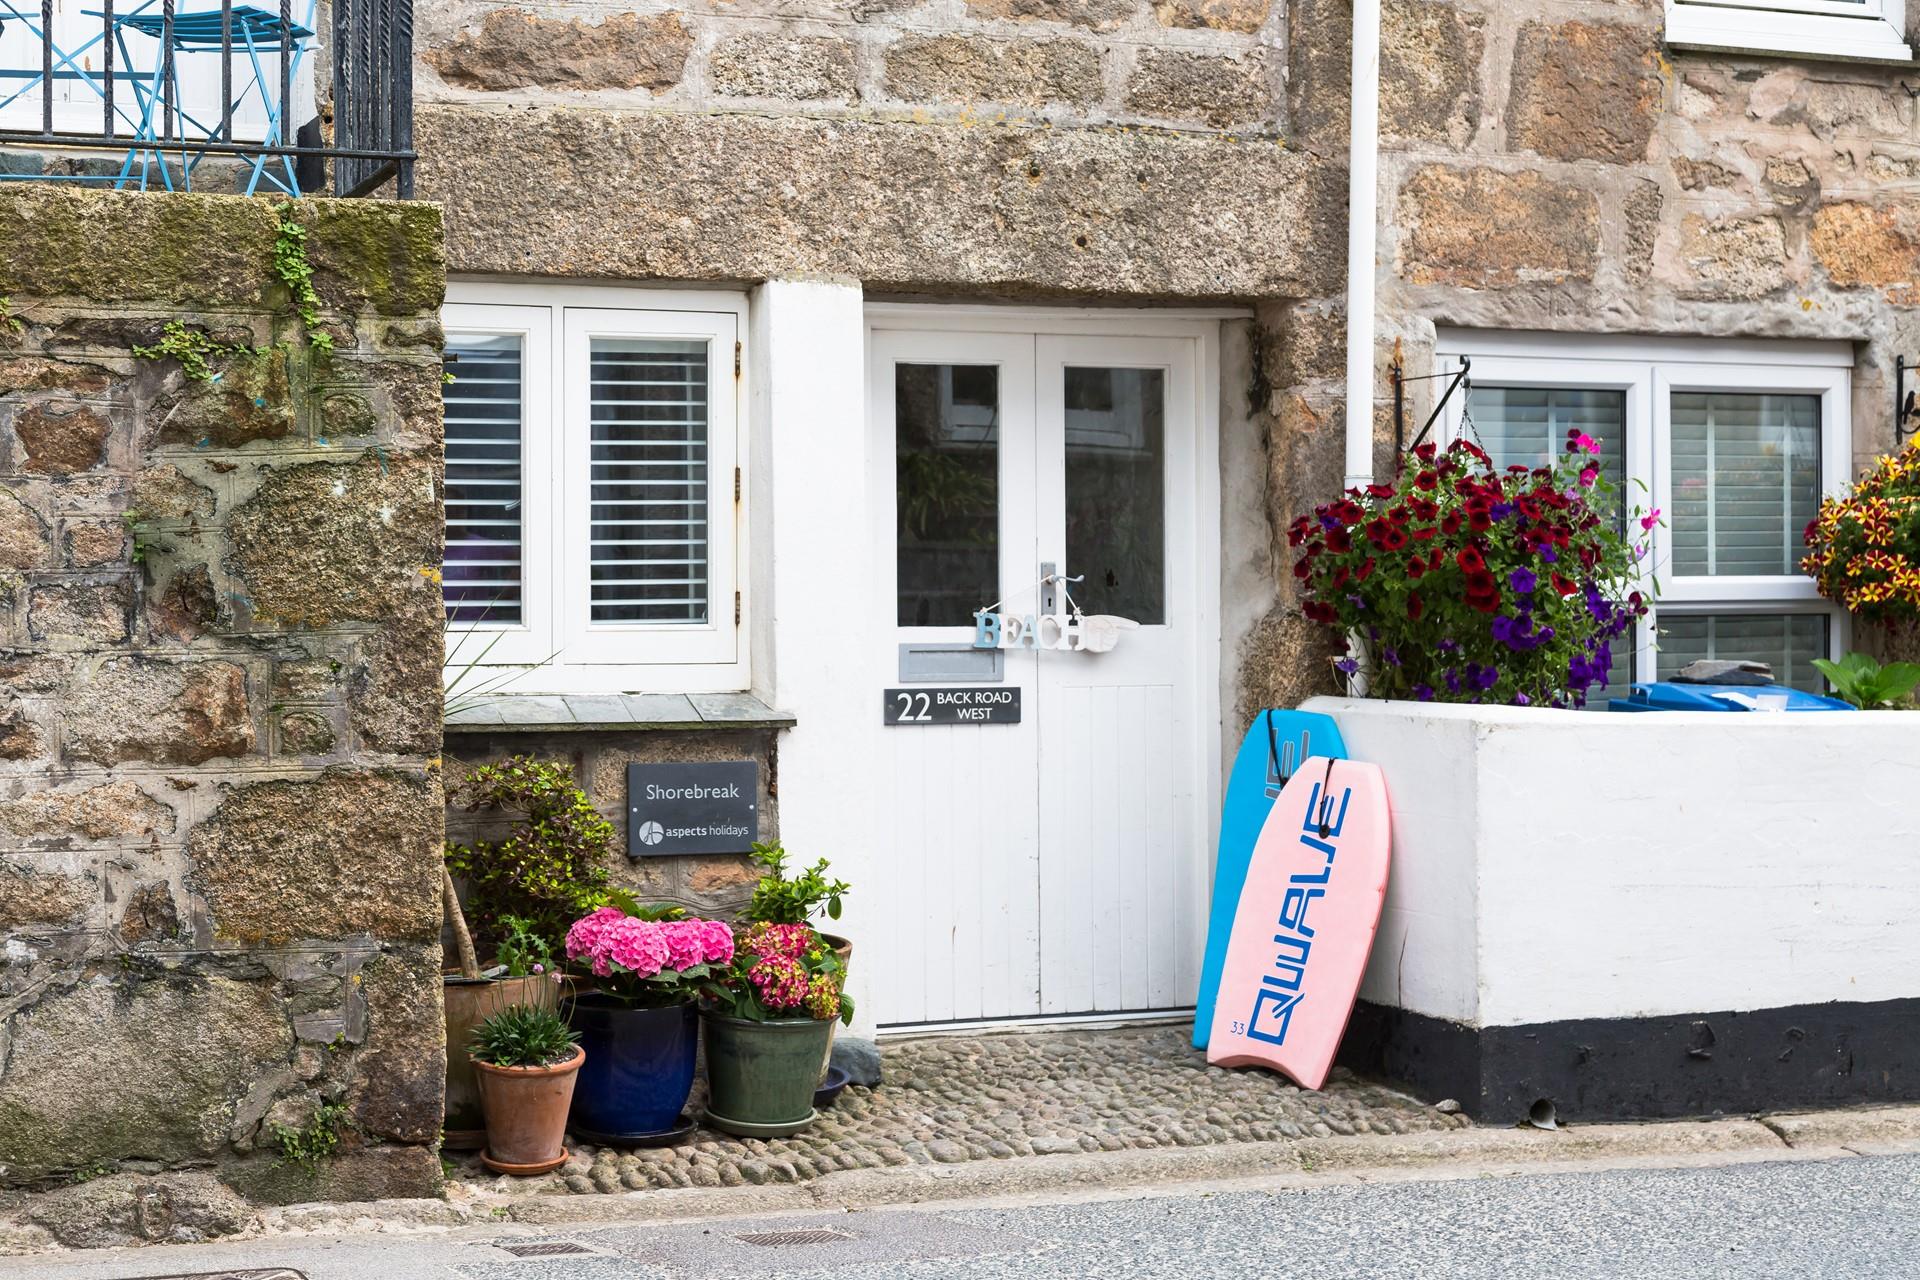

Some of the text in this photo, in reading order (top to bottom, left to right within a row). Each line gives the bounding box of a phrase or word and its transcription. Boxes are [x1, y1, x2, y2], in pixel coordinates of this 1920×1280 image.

[973, 611, 1086, 651] BEACH
[897, 692, 1012, 721] 22 BACK ROAD
[957, 707, 993, 720] WEST
[646, 783, 740, 800] Shorebreak
[666, 825, 749, 838] aspects holidays
[1246, 782, 1351, 1046] QWAVE
[1230, 1021, 1245, 1035] 33
